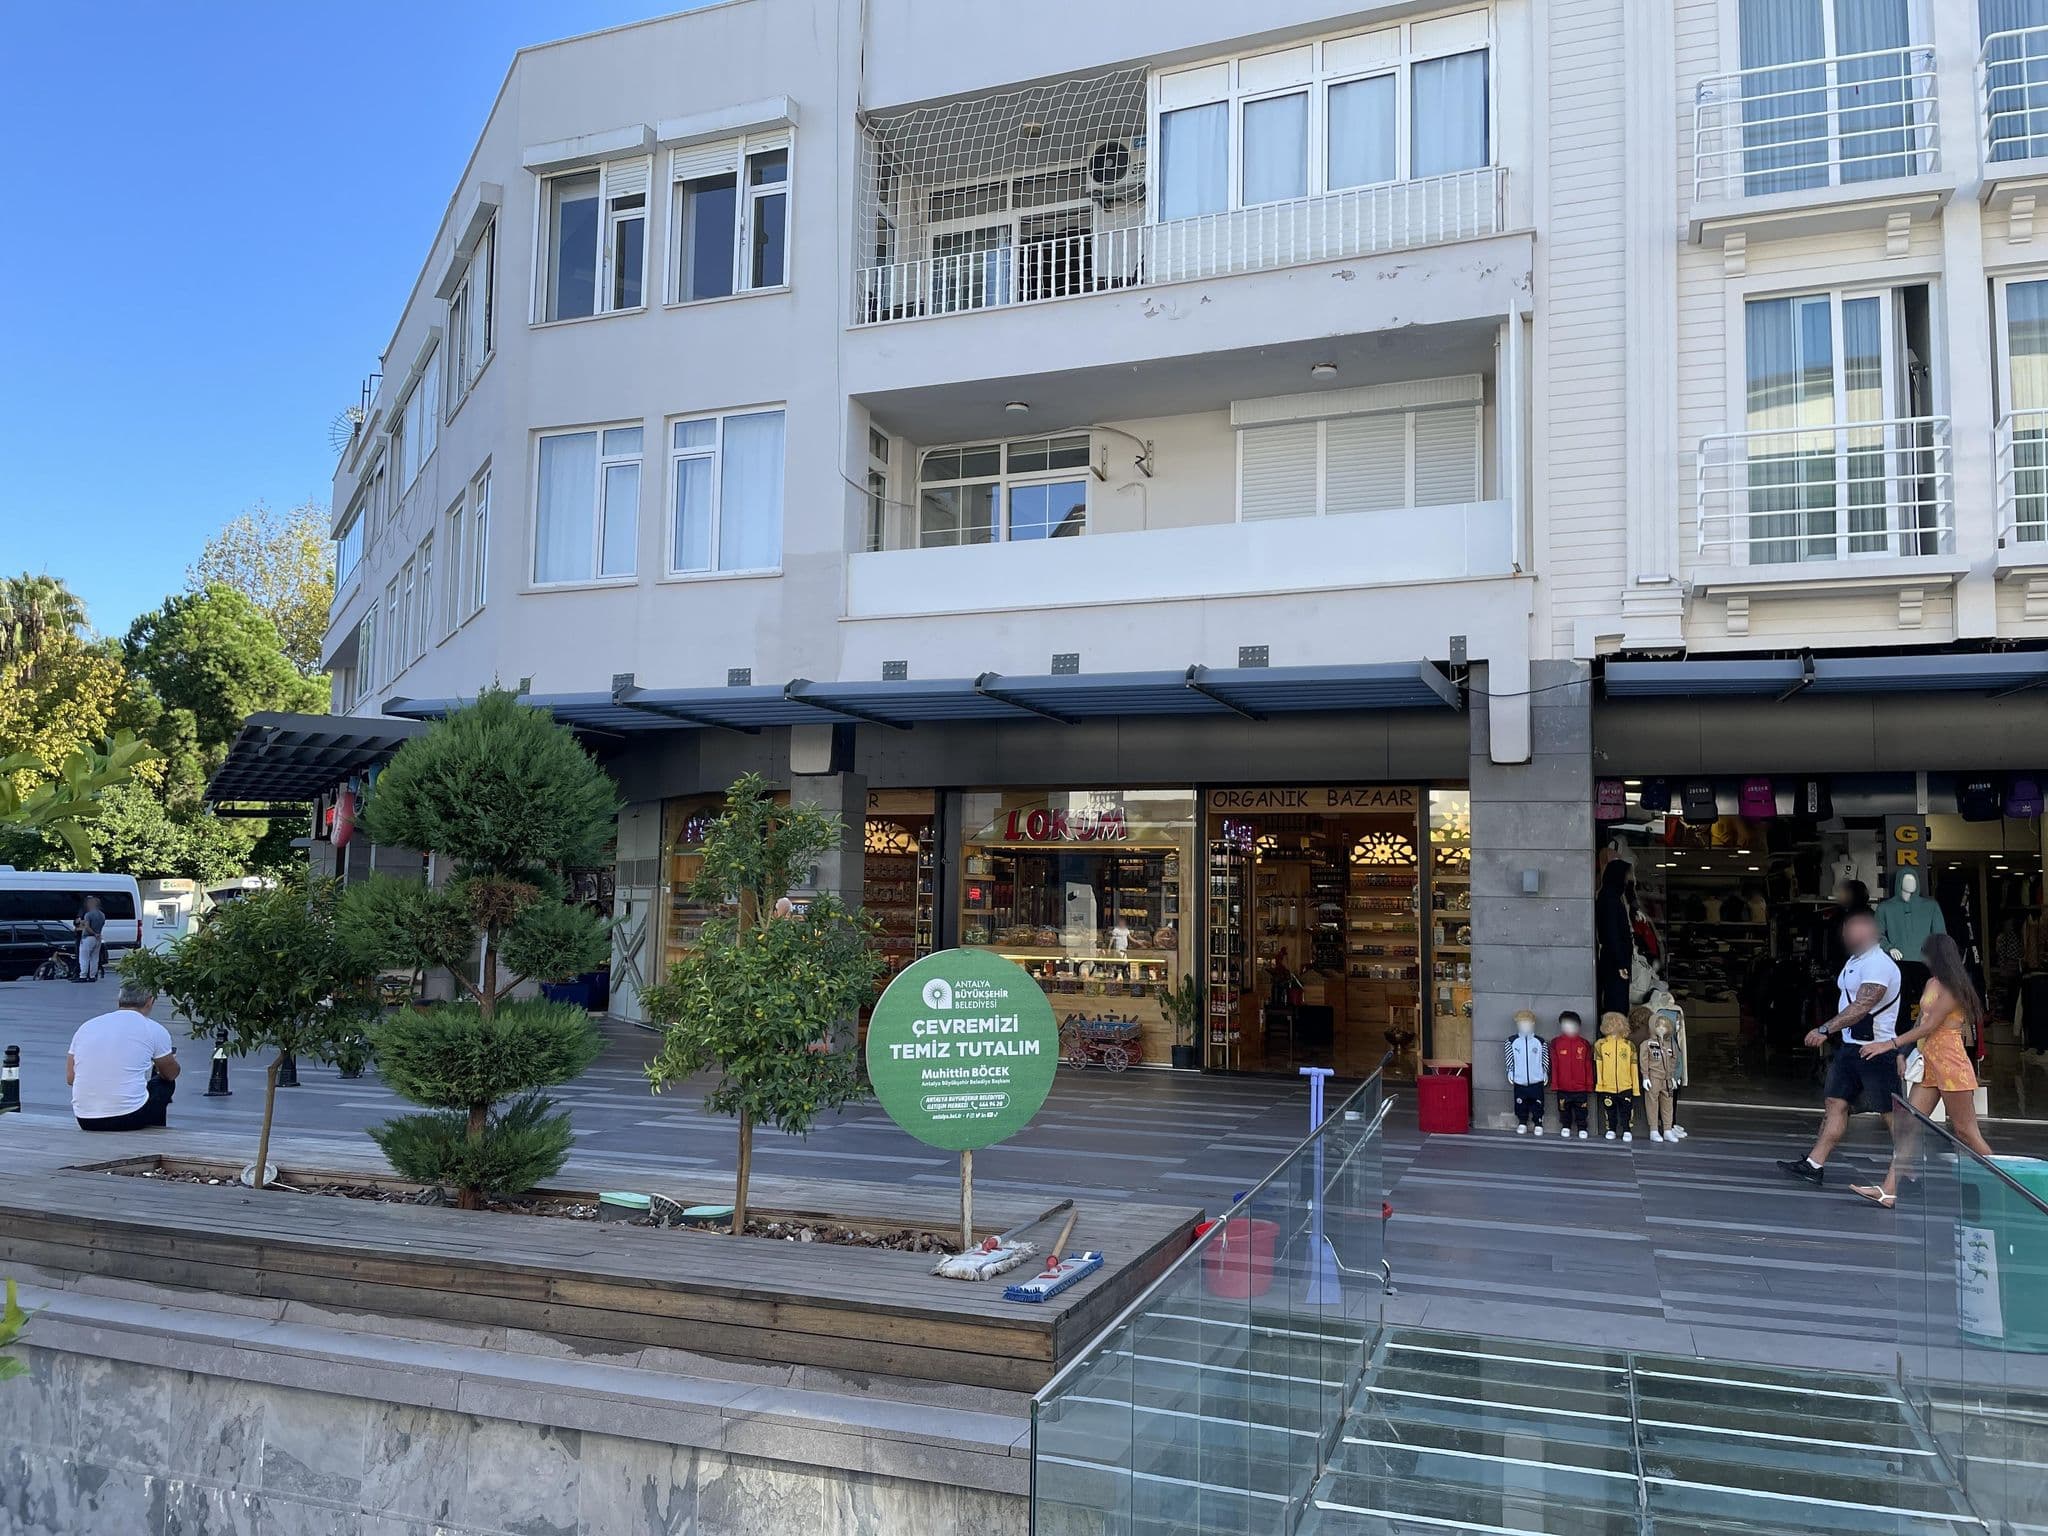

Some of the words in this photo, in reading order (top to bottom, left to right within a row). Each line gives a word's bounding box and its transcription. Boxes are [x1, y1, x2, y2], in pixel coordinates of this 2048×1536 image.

[1213, 790, 1308, 808] ORGANIK
[1327, 789, 1413, 807] BAZAAR
[1003, 807, 1127, 841] LOKUM
[955, 980, 990, 988] ANTALYA
[955, 988, 1008, 999] BÜYÜKŞEHİR
[955, 1000, 997, 1009] BELEDİYESİ
[912, 1014, 1019, 1038] ÇEVREMİZİ
[889, 1039, 951, 1060] TEMİZ
[956, 1040, 1040, 1057] TUTALIM
[921, 1067, 970, 1079] Muhittin
[971, 1064, 1010, 1077] BÖCEK
